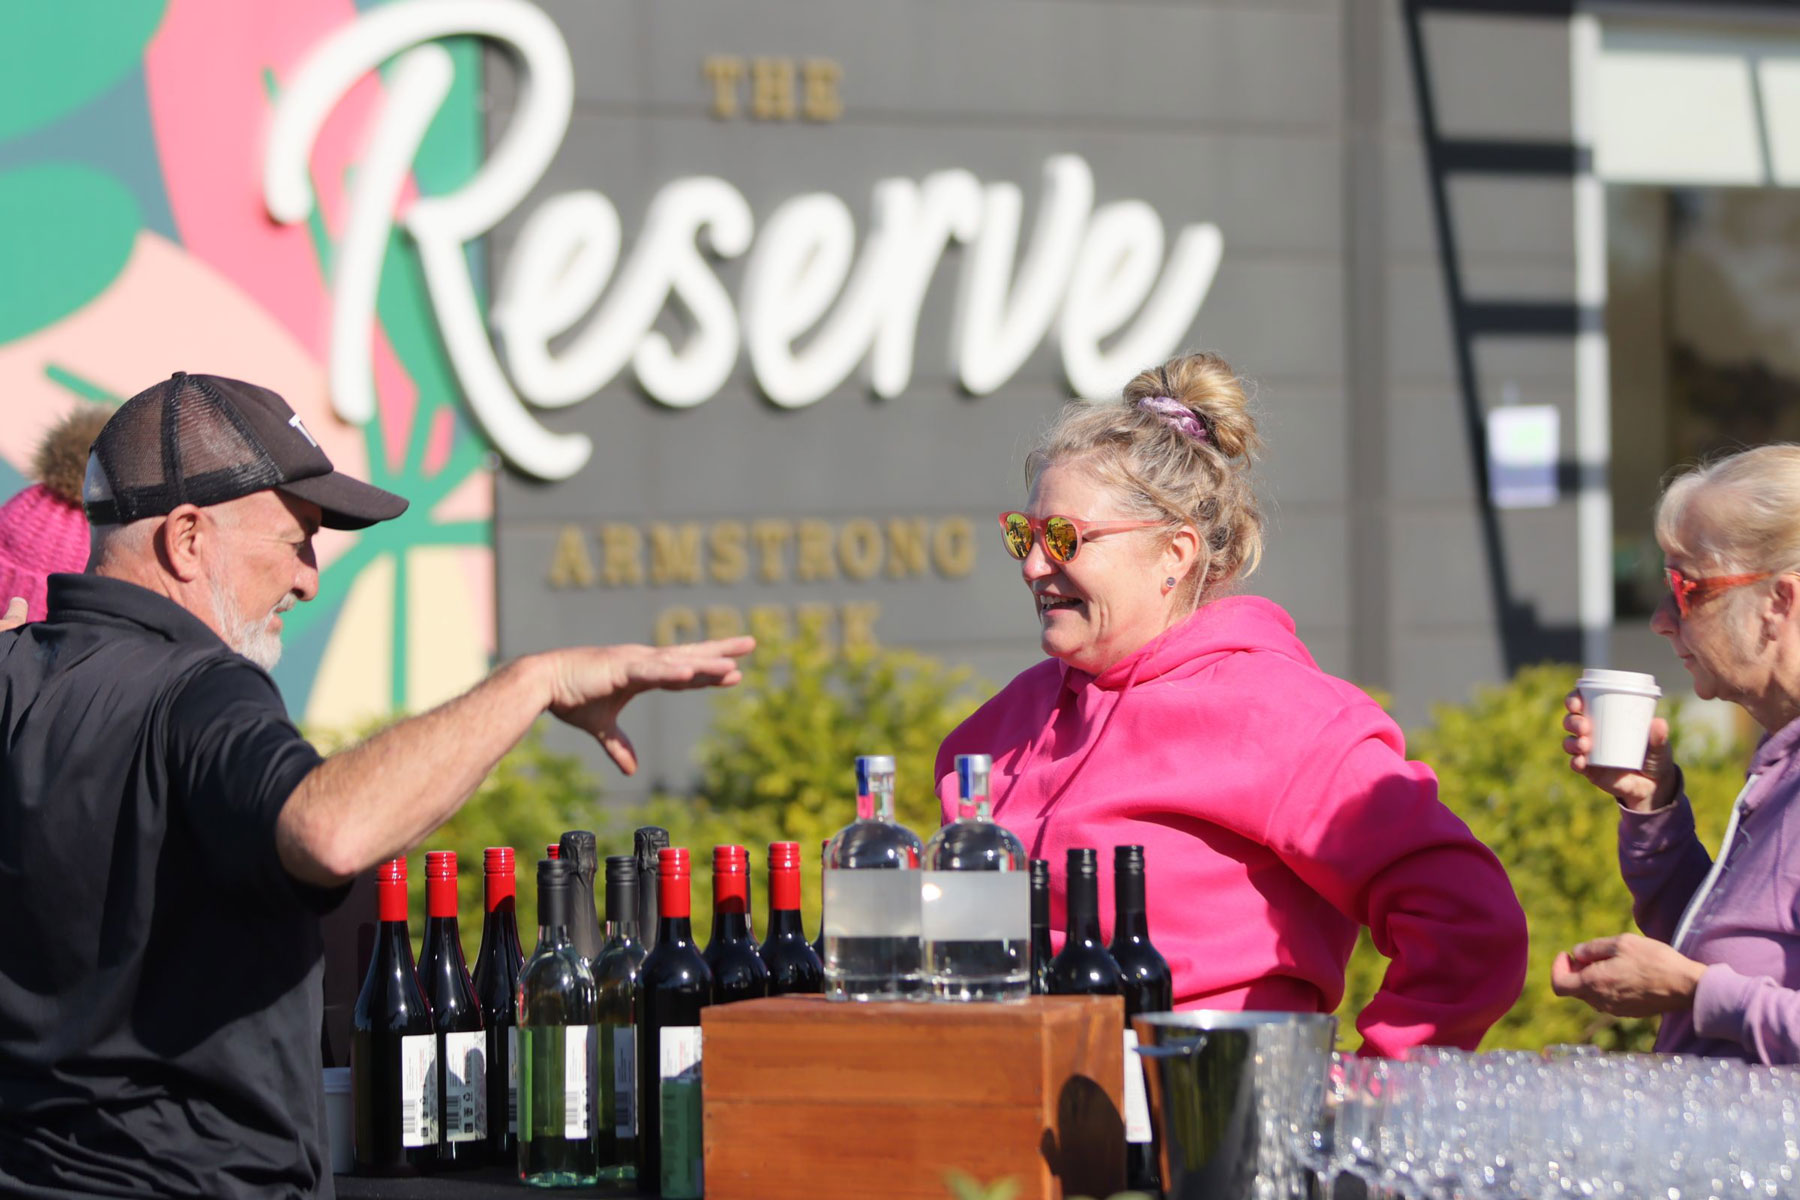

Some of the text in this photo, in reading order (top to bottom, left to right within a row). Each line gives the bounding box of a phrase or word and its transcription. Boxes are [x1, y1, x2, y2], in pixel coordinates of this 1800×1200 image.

[704, 55, 844, 121] THE
[264, 0, 1224, 480] Reserve
[551, 516, 977, 589] ARMSTRONG
